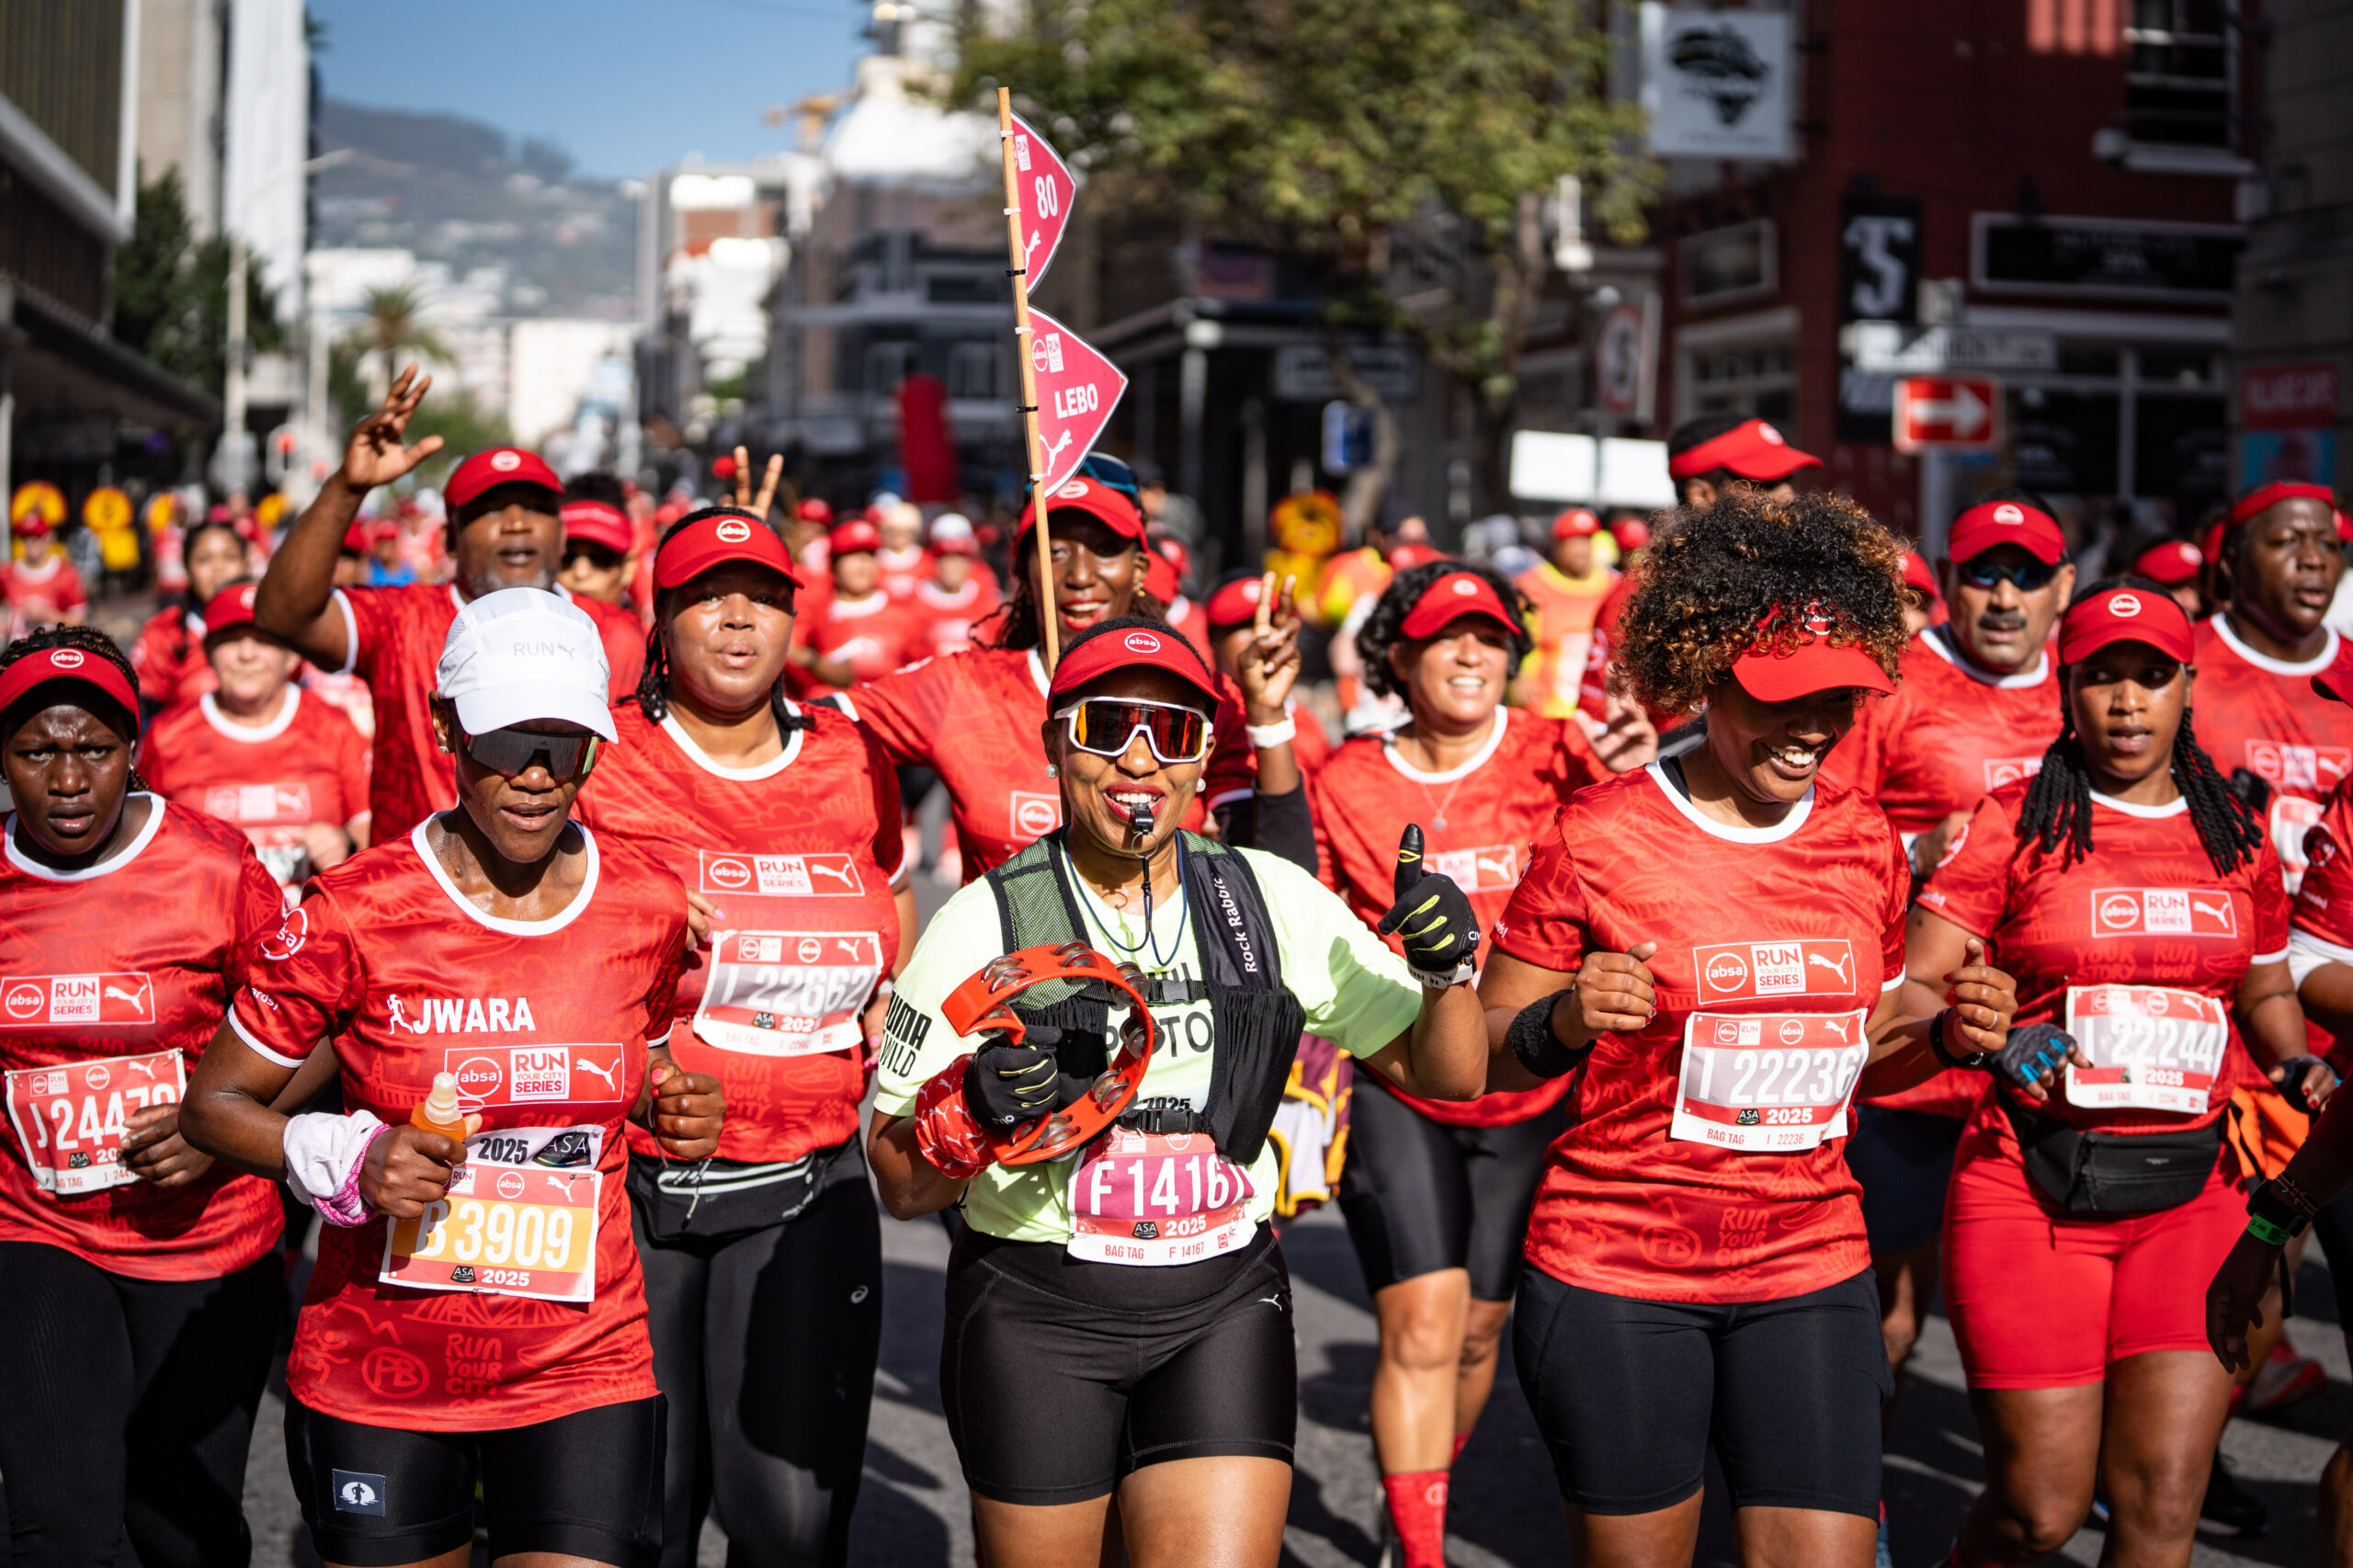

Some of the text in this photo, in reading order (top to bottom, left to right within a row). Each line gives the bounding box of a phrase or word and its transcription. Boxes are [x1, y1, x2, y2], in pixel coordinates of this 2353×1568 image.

[1035, 174, 1058, 219] 80
[1048, 338, 1060, 353] RUN
[1054, 383, 1098, 419] LEBO
[722, 525, 746, 535] absa
[514, 641, 554, 656] RUN
[1129, 637, 1156, 647] absa
[54, 653, 81, 662] absa
[714, 866, 748, 878] absa
[759, 860, 802, 873] RUN
[763, 879, 805, 888] SERIES
[2105, 903, 2135, 917] absa
[2148, 895, 2185, 908] RUN
[2149, 916, 2185, 926] SERIES
[1234, 931, 1258, 972] Rock
[1756, 949, 1800, 966] RUN
[2074, 941, 2198, 964] YOUR RUN
[1711, 965, 1744, 979] absa
[2153, 963, 2197, 980] YOUR
[1759, 974, 1799, 987] SERIES
[55, 982, 96, 998] RUN
[746, 966, 872, 1016] 22662
[10, 993, 40, 1006] absa
[53, 1005, 94, 1016] SERIES
[413, 996, 536, 1035] JWARA
[755, 1013, 776, 1024] ASA
[1721, 1025, 1802, 1037] absa RUN absa
[76, 1035, 126, 1054] RUN
[2109, 1017, 2218, 1073] 22244
[515, 1051, 566, 1073] RUN
[879, 1035, 917, 1078] WILD
[50, 1074, 65, 1083] RUN
[88, 1071, 108, 1083] absa
[460, 1069, 498, 1083] absa
[724, 1059, 773, 1085] RUN
[1729, 1049, 1860, 1105] 22236
[2146, 1069, 2185, 1086] 2025
[515, 1080, 563, 1094] SERIES
[723, 1082, 772, 1103] YOUR
[1738, 1108, 1813, 1125] ASA 2025
[28, 1102, 48, 1149] J
[1706, 1128, 1725, 1143] BAG
[1728, 1131, 1745, 1145] TAG
[1777, 1132, 1805, 1145] 22236
[70, 1152, 89, 1164] ASA
[477, 1134, 588, 1165] 2025 ASA
[69, 1176, 84, 1188] TAG
[452, 1170, 522, 1190] RUN absa
[1090, 1160, 1115, 1216] F
[1135, 1214, 1207, 1237] ASA 2025
[1720, 1206, 1769, 1232] RUN
[415, 1199, 449, 1257] B
[454, 1200, 574, 1270] 3909
[1718, 1229, 1766, 1248] YOUR
[1105, 1242, 1205, 1259] BAG TAG F 14167
[1650, 1229, 1693, 1259] PB
[453, 1265, 530, 1287] ASA 2025
[446, 1333, 503, 1362] RUN
[374, 1354, 419, 1389] PB
[446, 1358, 504, 1381] YOUR
[445, 1377, 500, 1395] CITY
